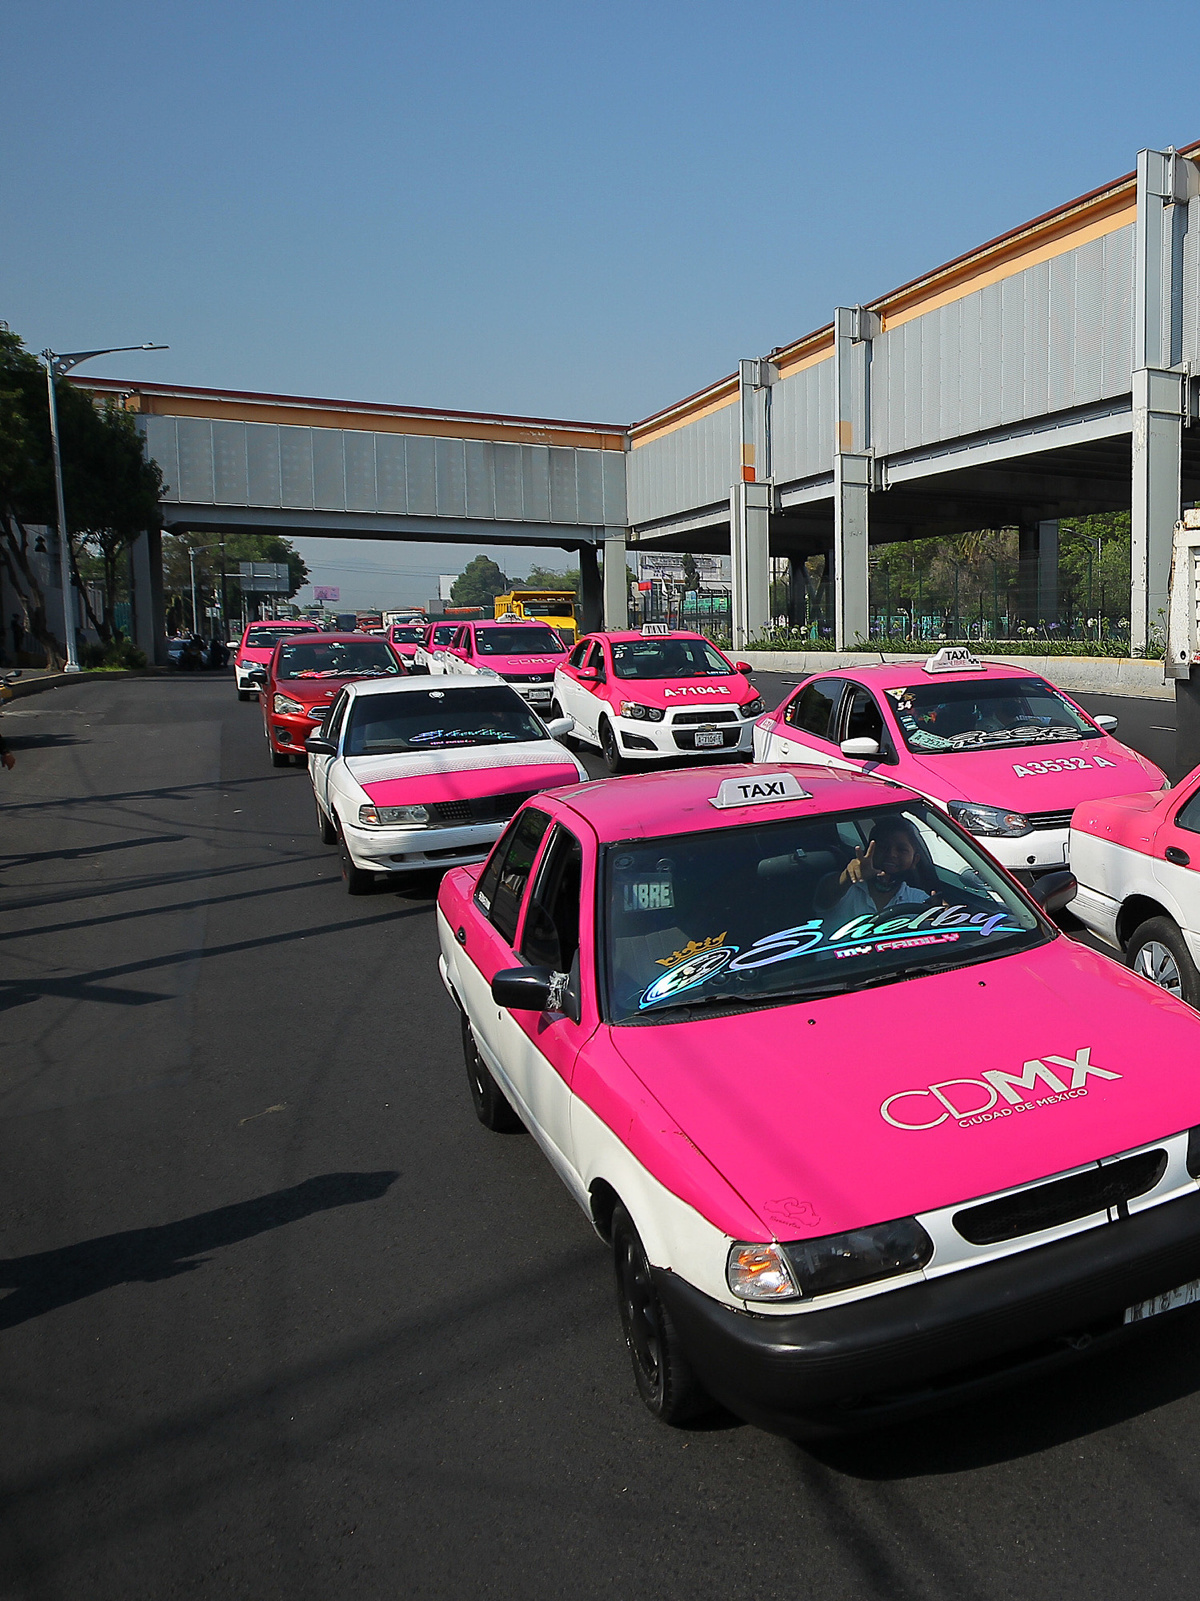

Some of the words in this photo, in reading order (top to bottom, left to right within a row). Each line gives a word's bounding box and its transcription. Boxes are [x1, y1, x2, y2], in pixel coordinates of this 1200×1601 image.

[645, 625, 666, 634] TAXI
[945, 650, 969, 660] TAXI
[664, 686, 731, 697] A-7104-E
[897, 700, 912, 711] 54
[1012, 757, 1093, 778] A3532
[1092, 755, 1117, 768] A
[737, 781, 785, 798] TAXI
[623, 882, 671, 910] LIBRE
[729, 904, 1009, 972] Shelby
[834, 945, 872, 959] MY
[876, 932, 960, 953] FAMILY
[880, 1046, 1124, 1131] CDMX
[958, 1107, 1012, 1128] CIUDAD
[1014, 1101, 1035, 1113] DE
[1036, 1087, 1089, 1108] MEXICO
